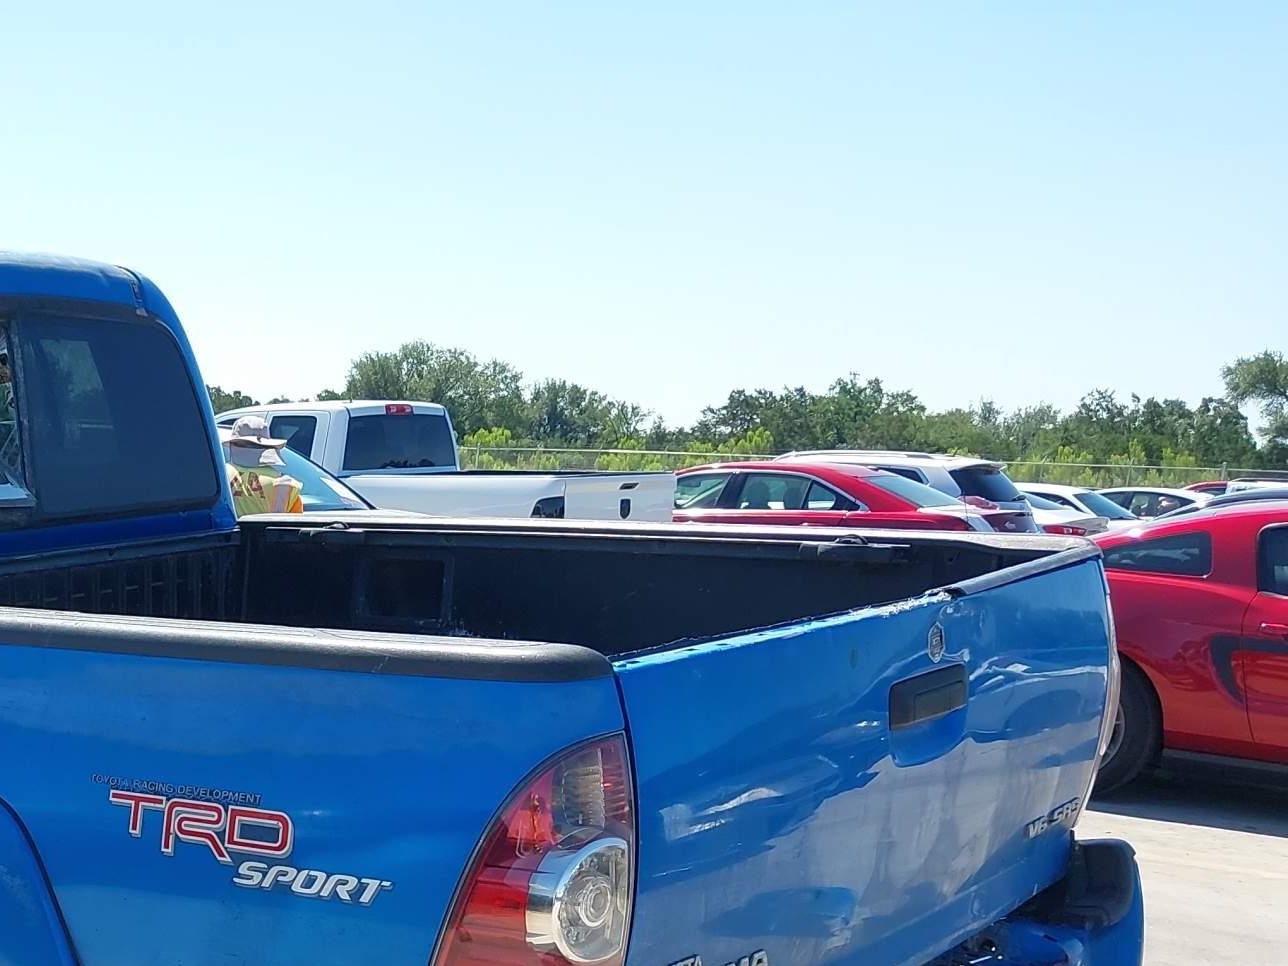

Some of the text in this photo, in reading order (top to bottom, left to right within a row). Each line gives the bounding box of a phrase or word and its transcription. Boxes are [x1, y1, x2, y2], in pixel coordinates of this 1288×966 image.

[90, 773, 262, 804] TOYOTA RACING DEVELOPMENT
[109, 789, 294, 864] TRD
[232, 860, 393, 906] SPORT
